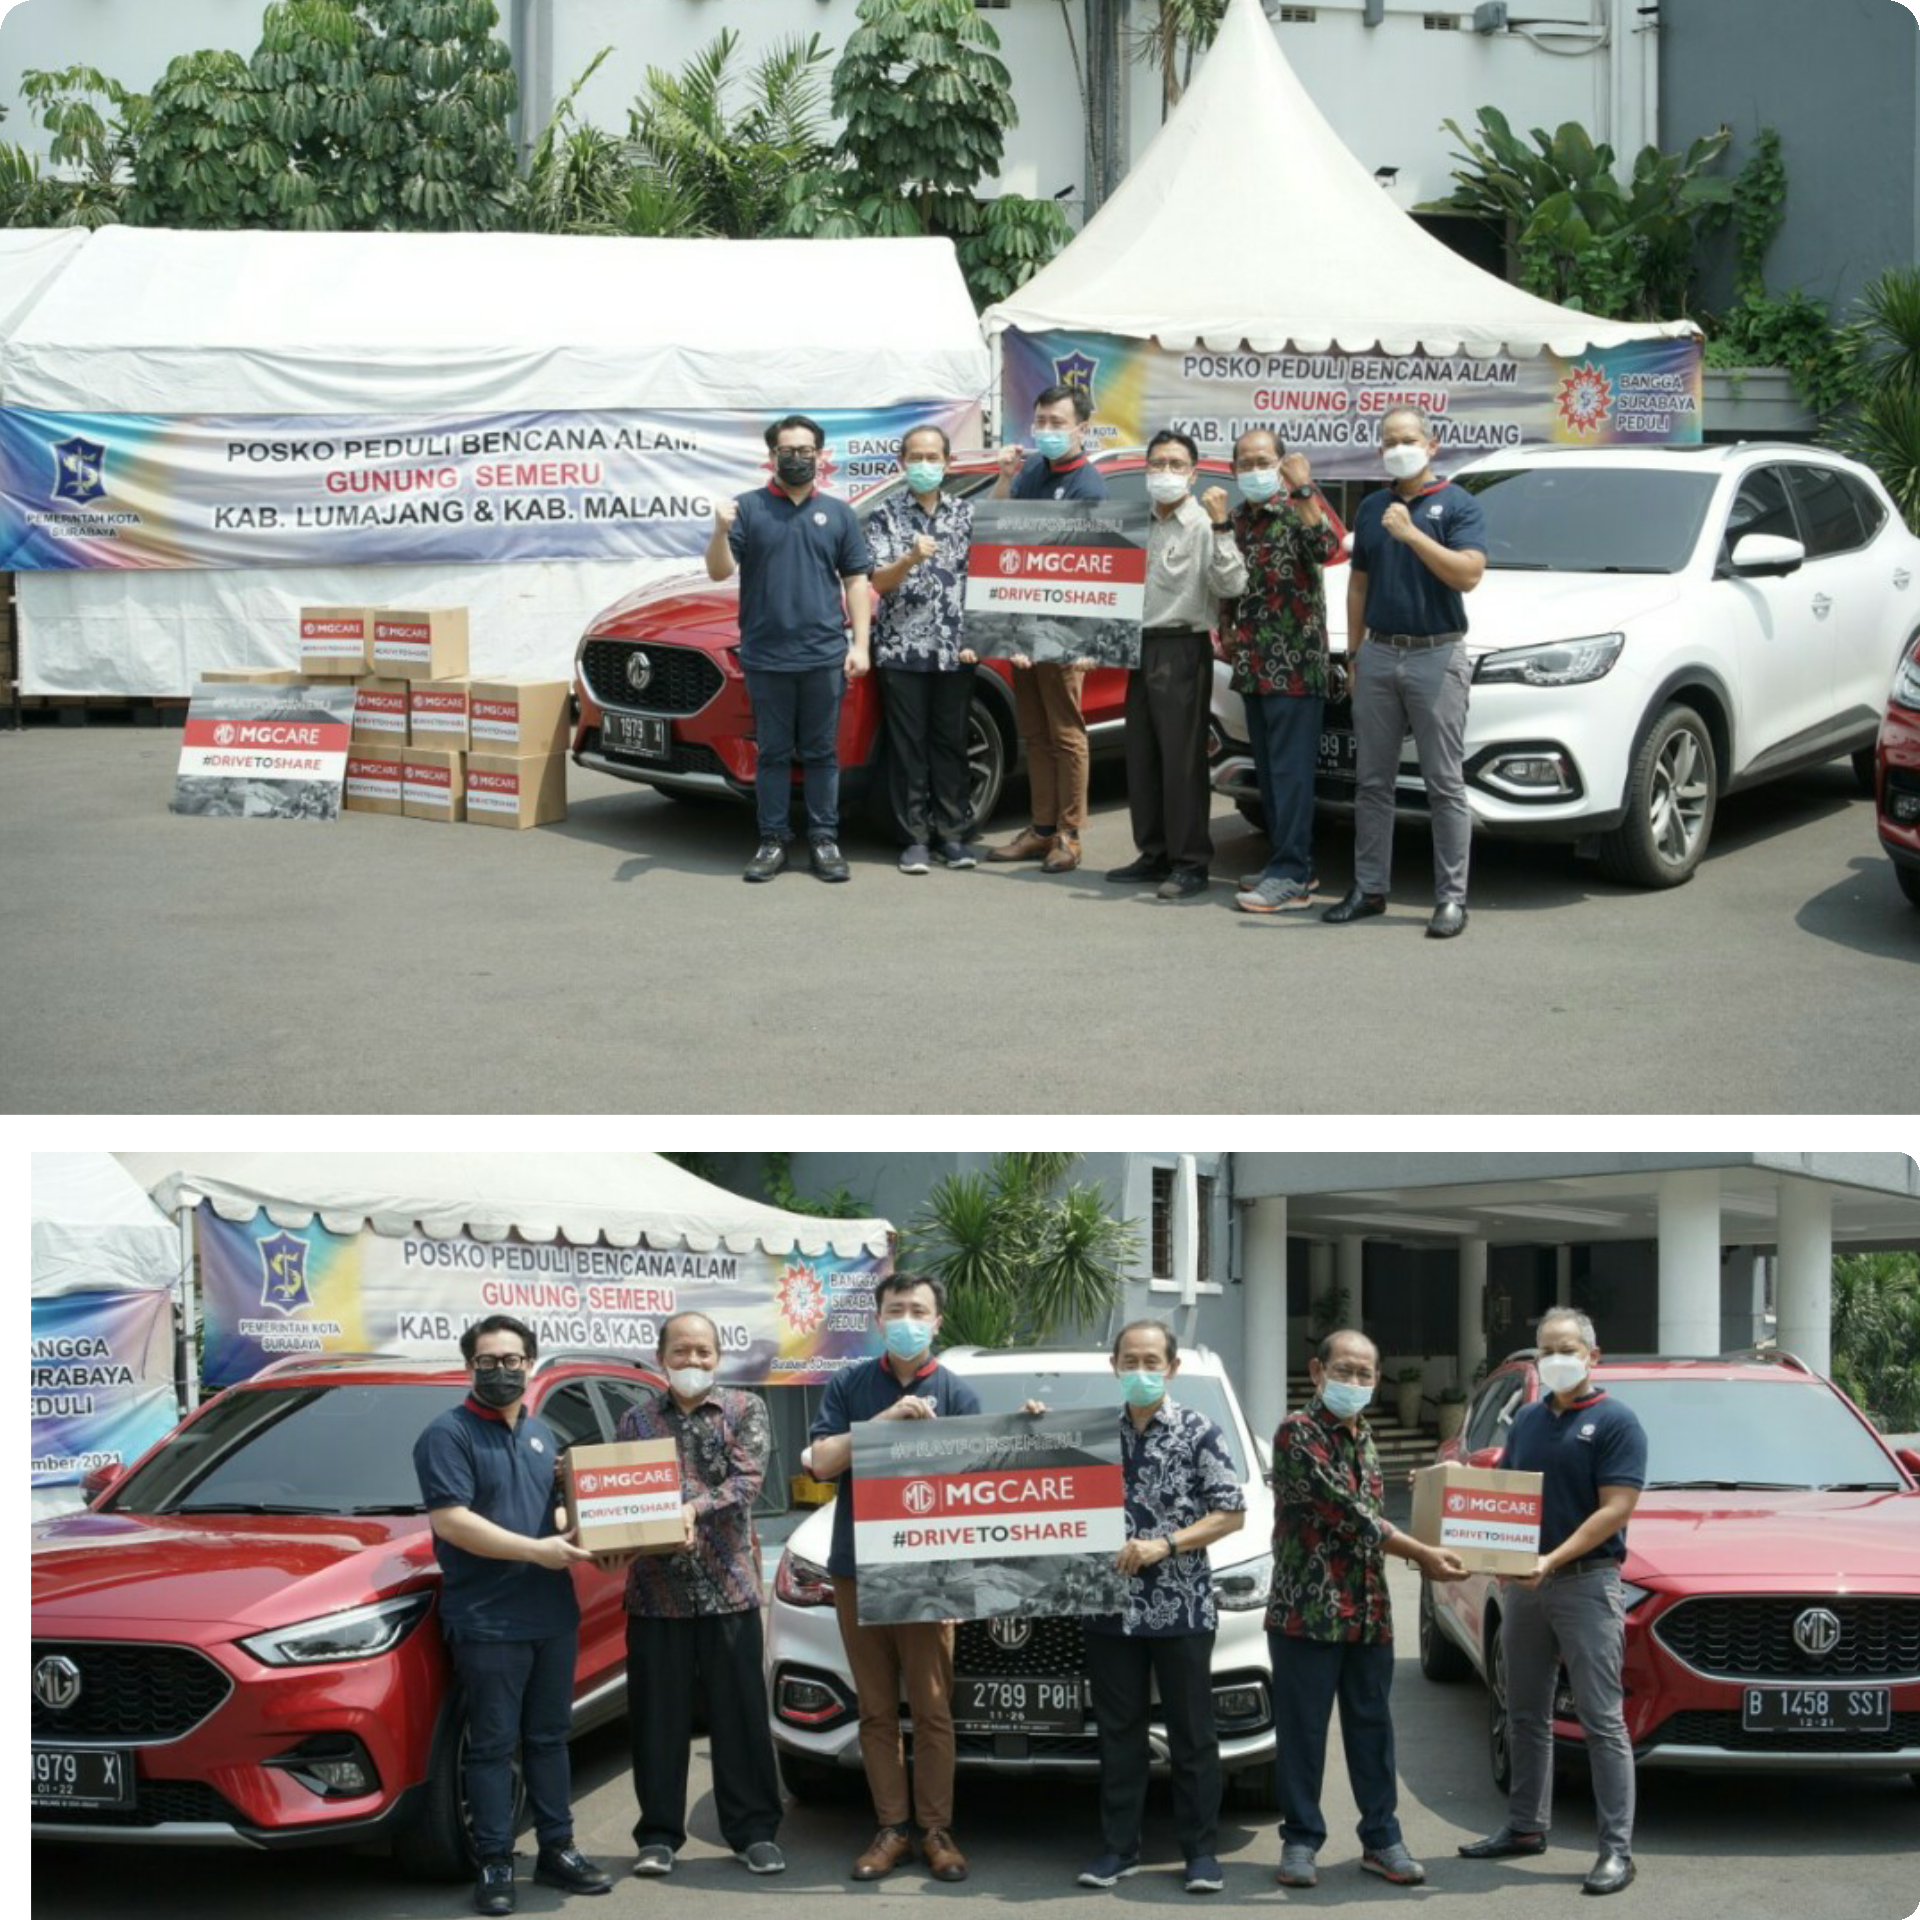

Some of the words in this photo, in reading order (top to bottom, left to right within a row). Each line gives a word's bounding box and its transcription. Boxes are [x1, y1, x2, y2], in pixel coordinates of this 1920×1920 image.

[1184, 357, 1260, 378] POSKO
[1268, 358, 1344, 380] PEDULI
[1351, 359, 1452, 381] BENCANA
[1457, 362, 1517, 382] ALAM
[1620, 374, 1682, 389] BANGGA
[1254, 391, 1346, 410] GUNUNG
[1619, 395, 1694, 411] SURABAYA
[1617, 415, 1669, 431] PEDULI
[1355, 423, 1368, 442] &
[1433, 424, 1519, 444] MALANG
[228, 442, 334, 462] POSKO
[345, 436, 451, 459] PEDULI
[462, 429, 602, 455] BENCANA
[848, 440, 901, 454] BANG
[326, 468, 457, 493] GUNUNG
[476, 463, 600, 486] SEMERU
[848, 463, 900, 476] SURA
[108, 514, 140, 523] KOTA
[215, 507, 285, 528] KAB.
[297, 501, 464, 527] LUMAJANG
[475, 502, 493, 522] &
[504, 499, 573, 521] KAB.
[585, 497, 711, 519] MALANG
[1026, 552, 1112, 574] MGCARE
[989, 587, 1118, 606] #DRIVETOSHARE
[240, 727, 321, 745] MGCARE
[203, 755, 322, 770] #DRIVETOSHARE
[404, 1241, 484, 1268] POSKO
[491, 1245, 571, 1273] PEDULI
[577, 1251, 675, 1278] BENCANA
[681, 1257, 737, 1280] ALAM
[483, 1282, 577, 1308] GUNUNG
[590, 1286, 675, 1312] SEMERU
[832, 1294, 875, 1309] SURABA
[312, 1323, 340, 1334] KOTA
[401, 1316, 457, 1341] KAB.
[593, 1321, 606, 1344] &
[613, 1323, 656, 1345] KAB
[263, 1337, 321, 1350] SURABAYA
[31, 1397, 92, 1416] DULI
[603, 1468, 673, 1488] MGCARE
[946, 1476, 1075, 1506] MGCARE
[1470, 1498, 1536, 1516] MGCARE
[892, 1521, 1087, 1548] #DRIVETOSHARE
[1444, 1528, 1535, 1545] #DRIVETOSHARE
[1795, 1609, 1840, 1653] MG
[974, 1683, 1027, 1709] 2789
[1750, 1690, 1762, 1715] B
[1781, 1690, 1829, 1715] 1458
